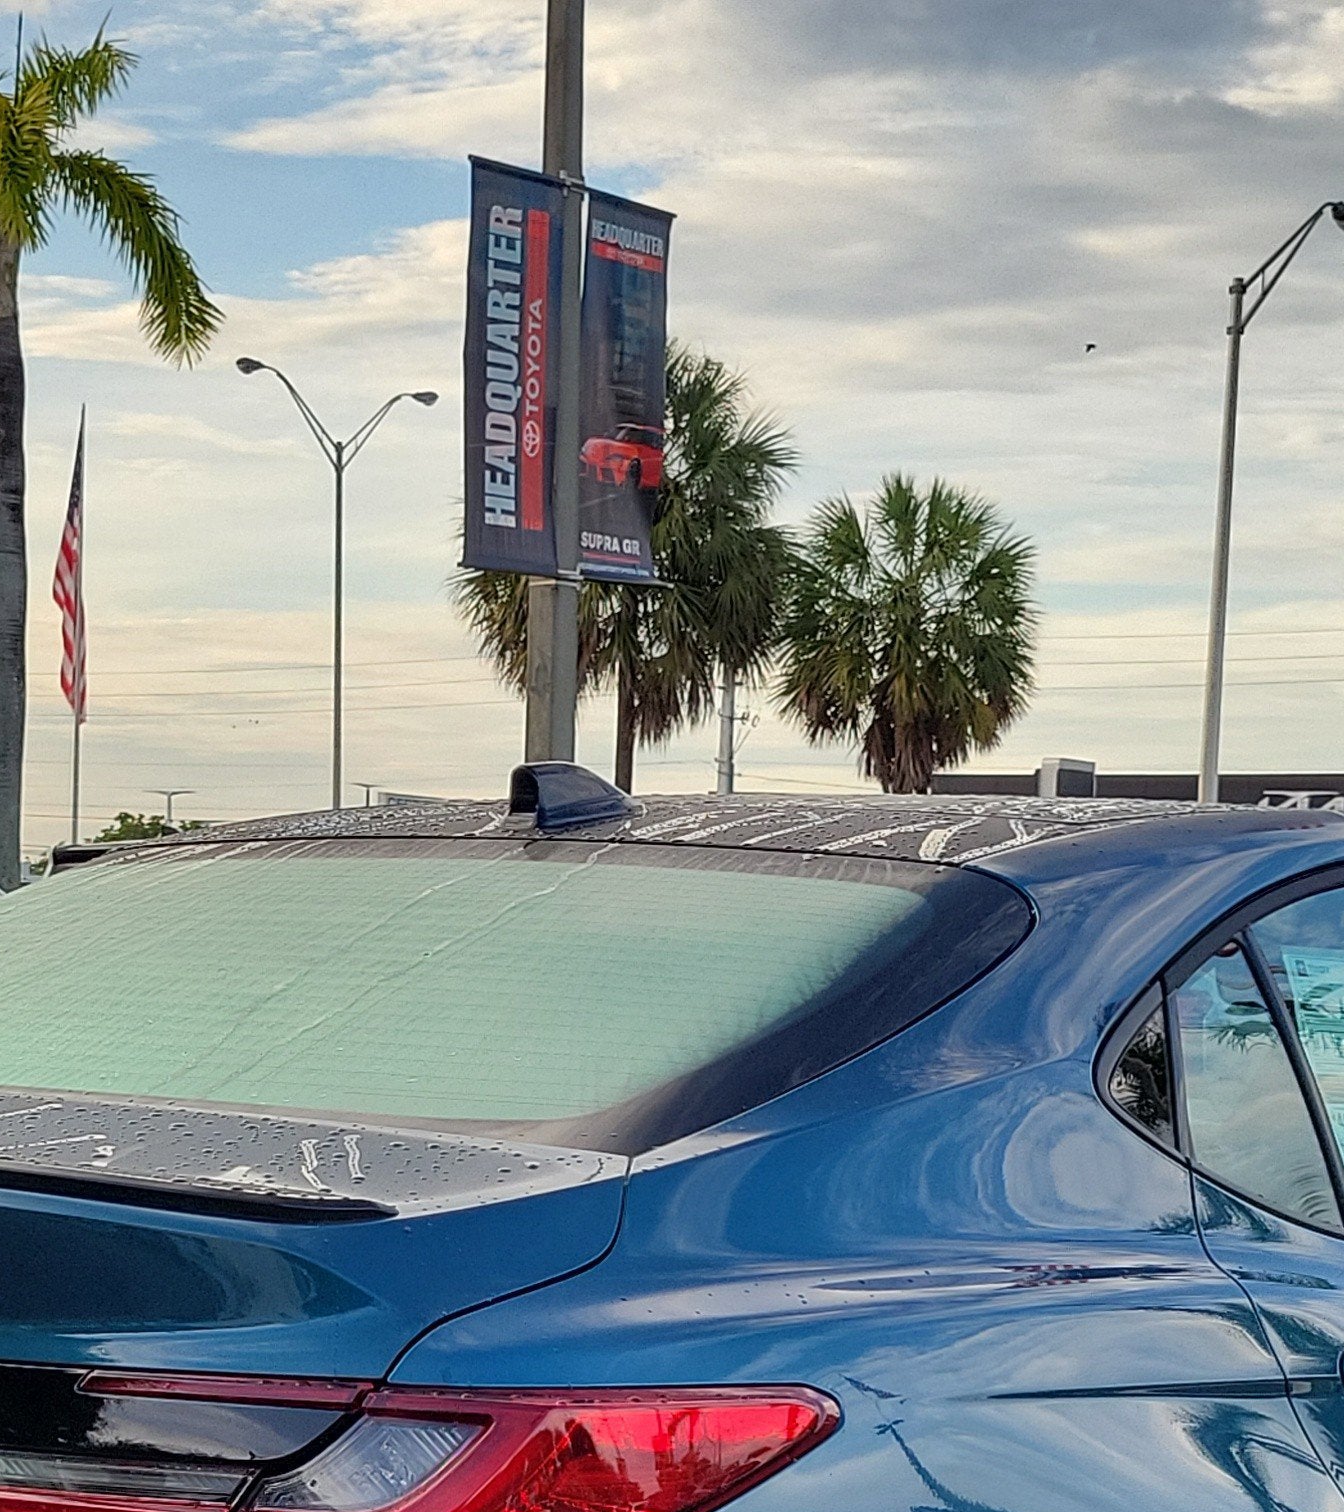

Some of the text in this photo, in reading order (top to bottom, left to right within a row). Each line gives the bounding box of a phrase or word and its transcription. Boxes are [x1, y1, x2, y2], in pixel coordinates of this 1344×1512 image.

[484, 204, 524, 528] HEADQUARTER
[525, 299, 544, 417] TOYOTA
[580, 531, 641, 556] SUPRA GR
